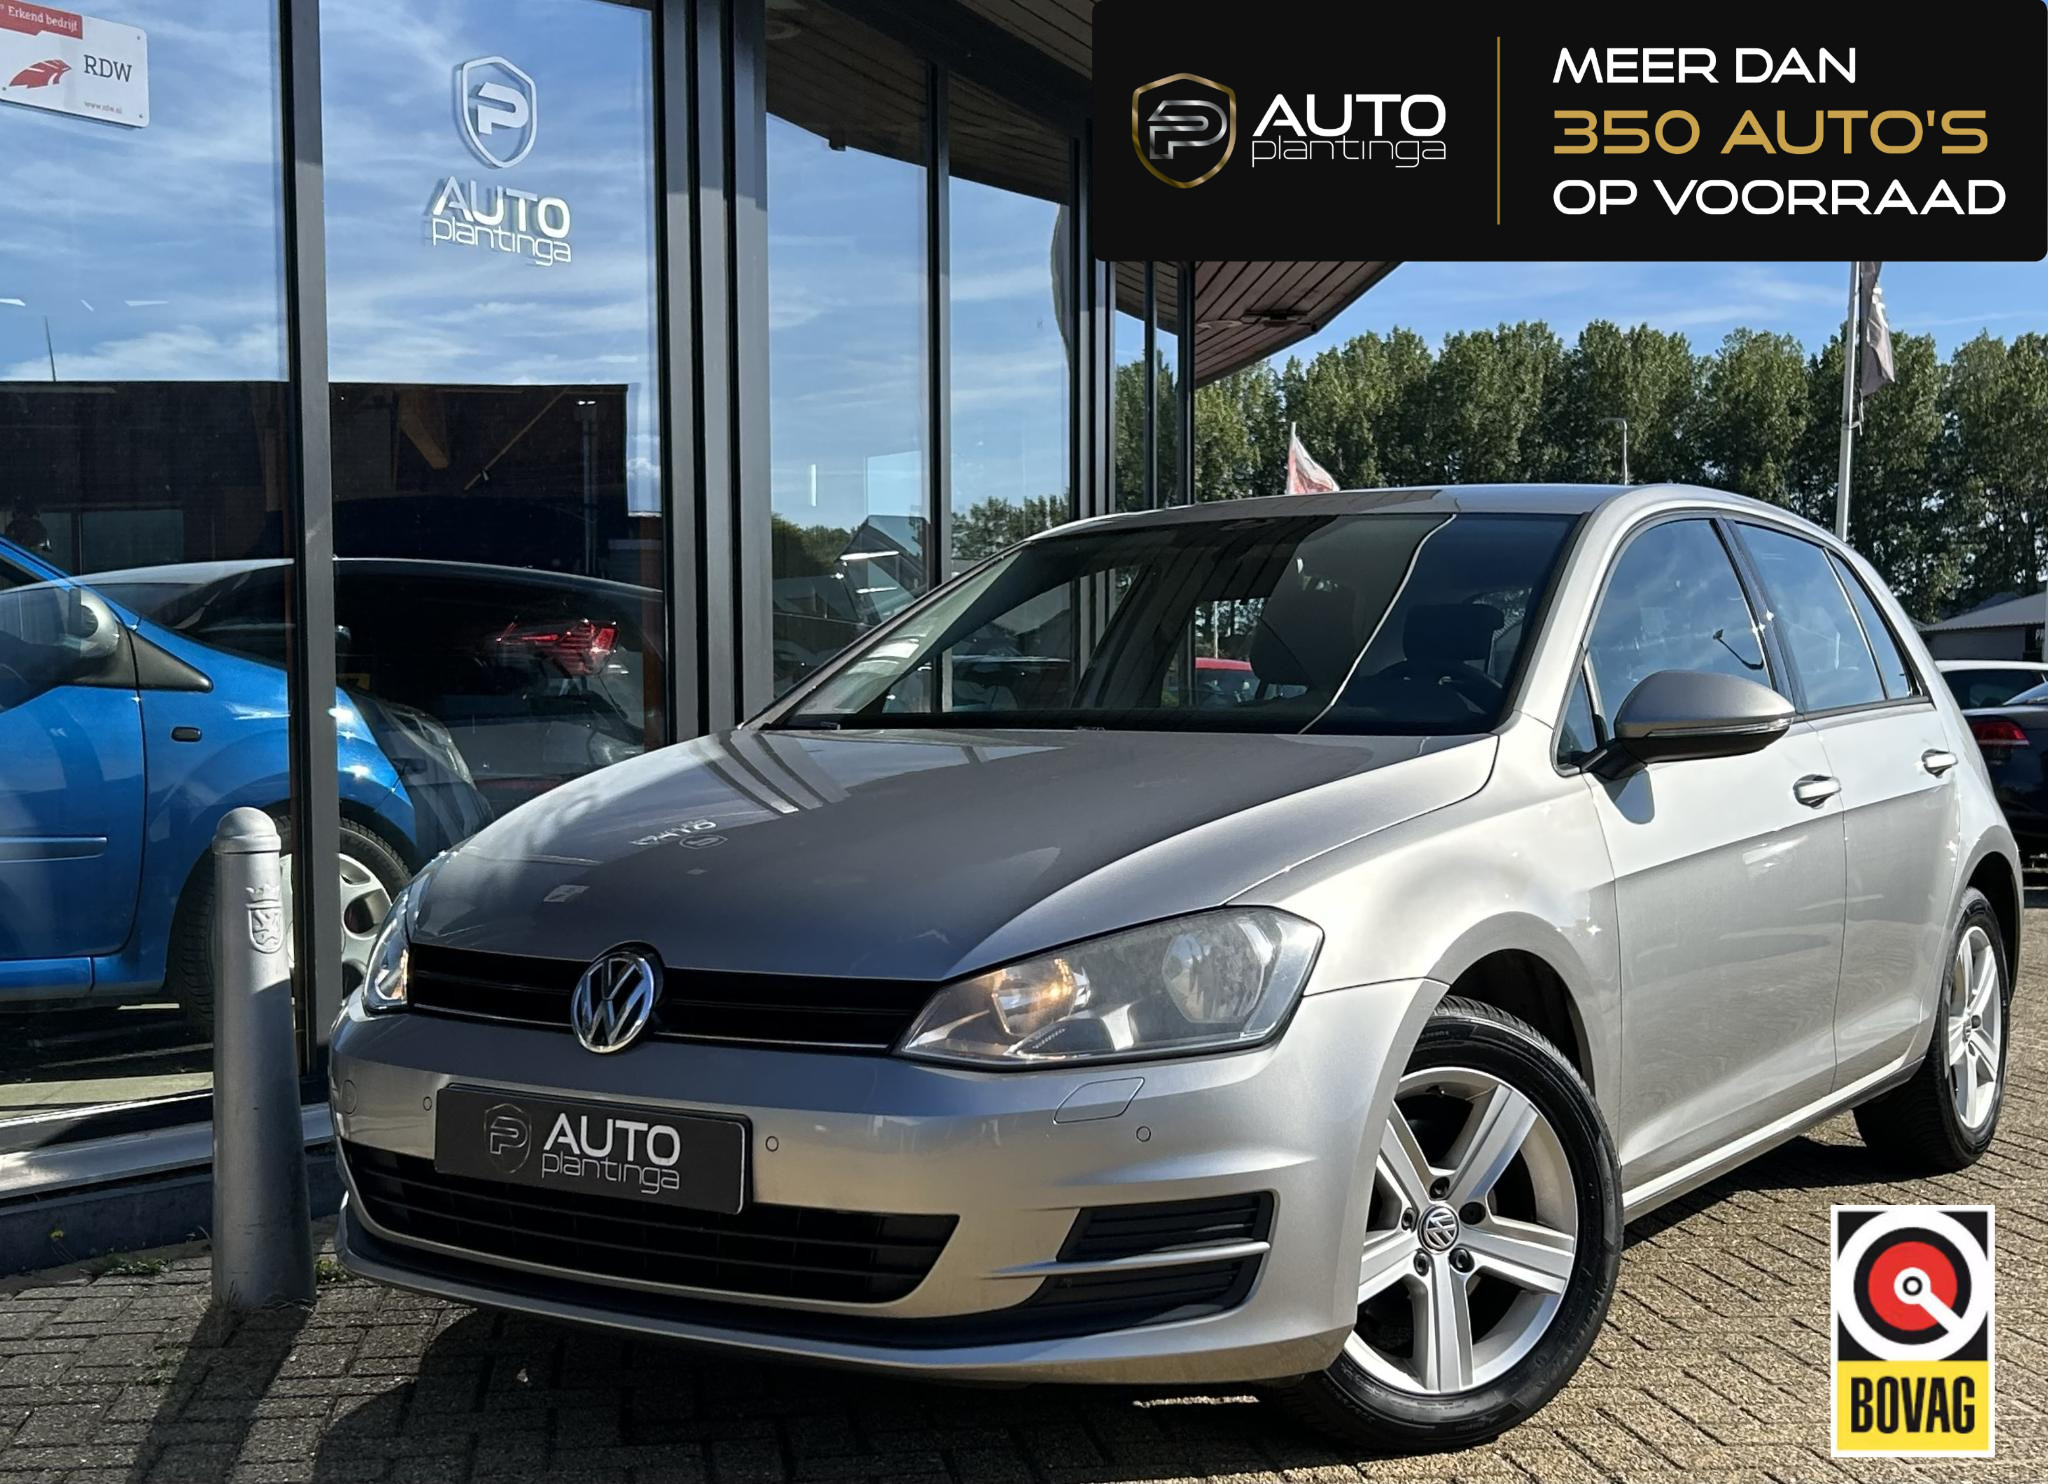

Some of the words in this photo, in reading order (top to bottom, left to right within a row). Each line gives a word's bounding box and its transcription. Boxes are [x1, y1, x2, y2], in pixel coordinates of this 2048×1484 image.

[7, 5, 44, 24] Erkend
[83, 54, 133, 83] RDW
[432, 176, 571, 239] AUTO
[431, 216, 573, 267] plantinga
[542, 1112, 682, 1167] AUTO
[540, 1150, 680, 1195] plantinga
